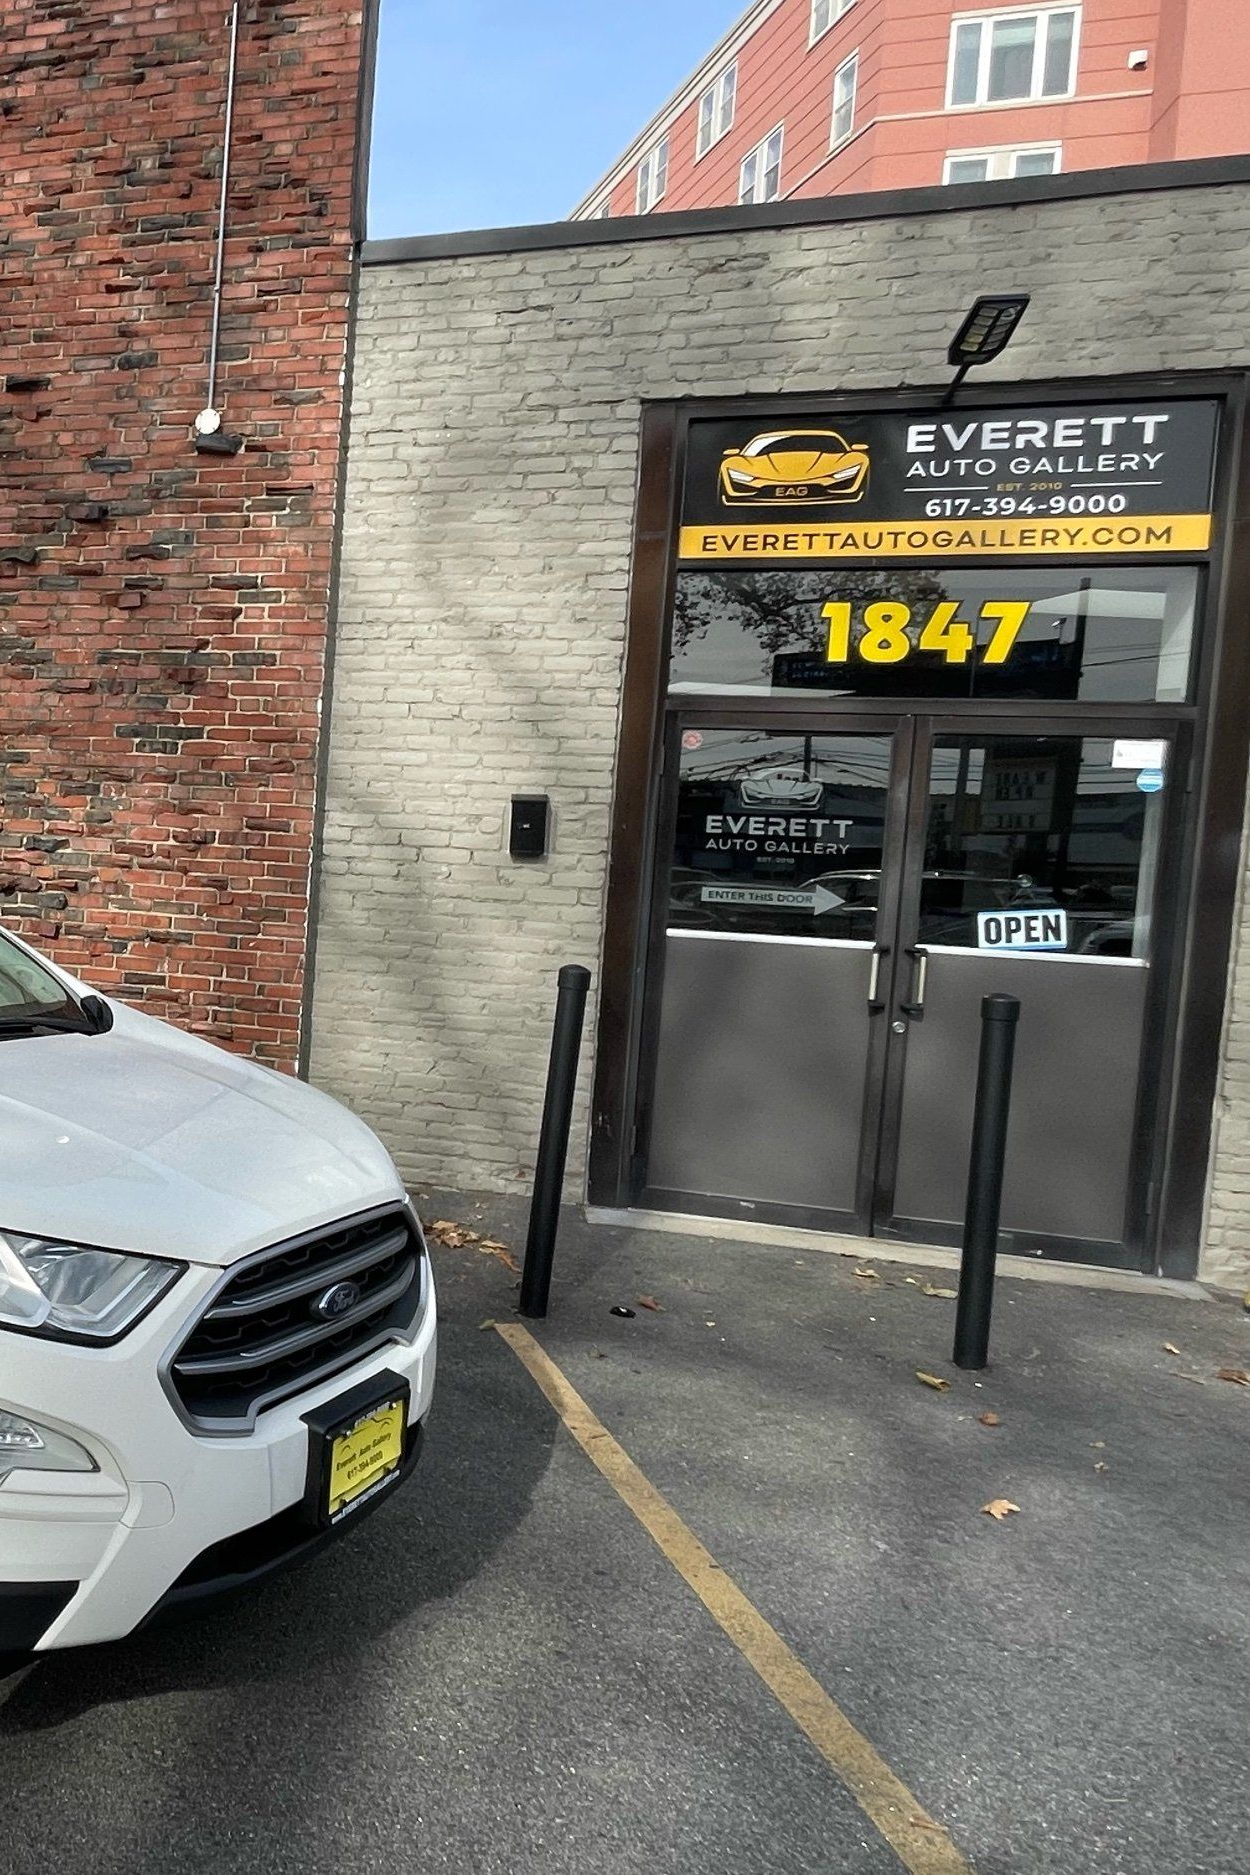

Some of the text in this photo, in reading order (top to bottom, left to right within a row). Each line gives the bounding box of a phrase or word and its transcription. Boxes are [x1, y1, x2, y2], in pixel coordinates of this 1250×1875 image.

[905, 413, 1170, 454] EVERETT
[906, 452, 1165, 478] AUTO GALLERY
[774, 486, 809, 498] EAG
[1029, 481, 1063, 491] 2010
[924, 493, 1127, 518] 617-394-9000
[701, 525, 1173, 554] EVERETTAUTOGALLERY.COM
[820, 600, 1031, 665] 1847
[705, 814, 854, 839] EVERETT
[705, 838, 850, 855] AUTO GALLERY
[708, 890, 814, 904] ENTER THIS DOOR
[983, 912, 1063, 947] OPEN
